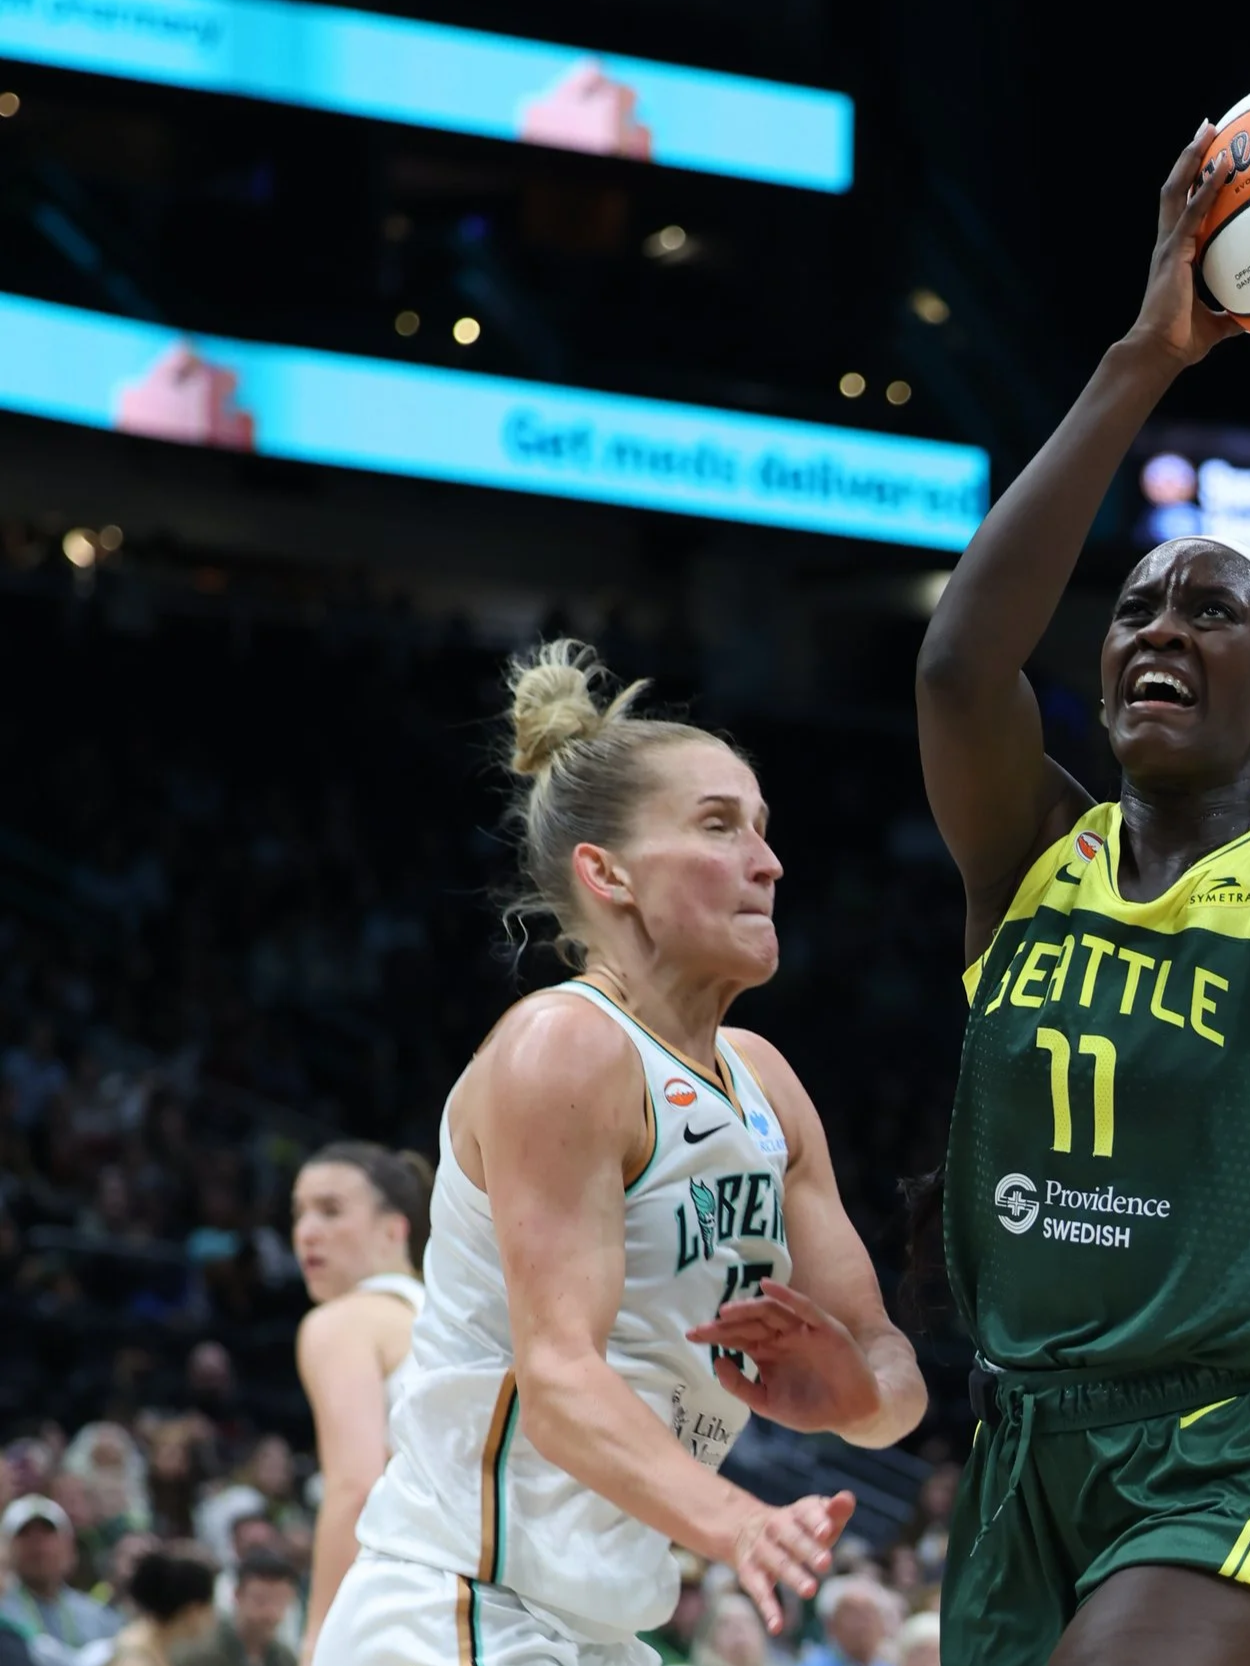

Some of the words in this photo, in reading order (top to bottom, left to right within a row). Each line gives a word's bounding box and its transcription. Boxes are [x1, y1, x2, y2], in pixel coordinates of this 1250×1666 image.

[985, 932, 1230, 1048] SEATTLE
[1035, 1026, 1117, 1158] 11
[1042, 1217, 1131, 1249] SWEDISH
[1044, 1179, 1171, 1218] Providence
